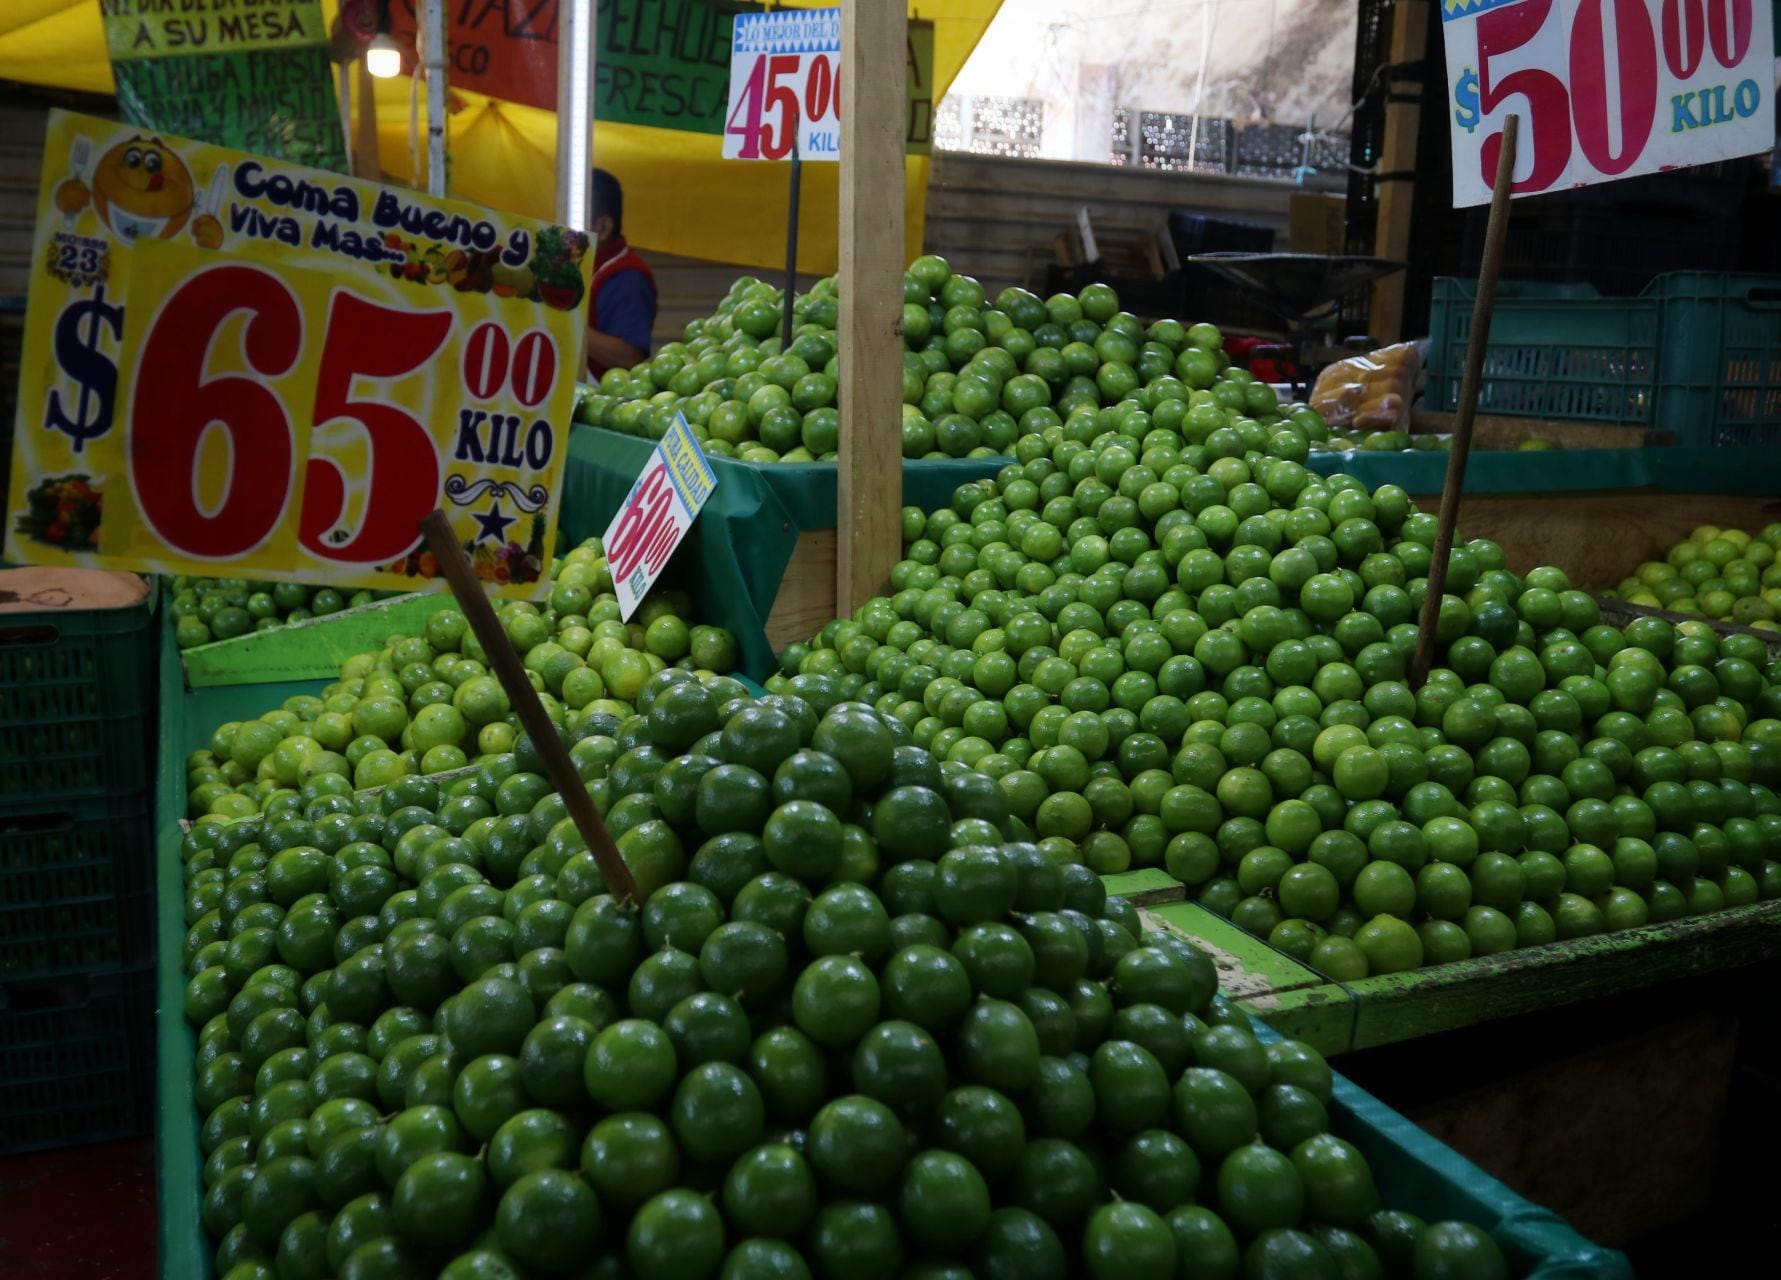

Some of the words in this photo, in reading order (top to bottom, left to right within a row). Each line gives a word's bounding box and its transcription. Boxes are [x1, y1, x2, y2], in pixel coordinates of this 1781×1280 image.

[132, 22, 155, 48] A
[163, 18, 207, 46] SU
[218, 9, 305, 43] MESA
[762, 23, 801, 41] MEJOR
[803, 21, 829, 39] DEL
[1671, 78, 1761, 133] KILO
[808, 131, 841, 152] KIL
[230, 202, 301, 247] Viva
[233, 161, 360, 223] Coma
[372, 190, 497, 250] Bueno
[500, 230, 530, 268] y
[60, 245, 98, 273] 23
[454, 408, 553, 471] KILO
[664, 427, 683, 461] PURA
[677, 450, 710, 506] CALIDAD
[628, 564, 648, 601] KILO
